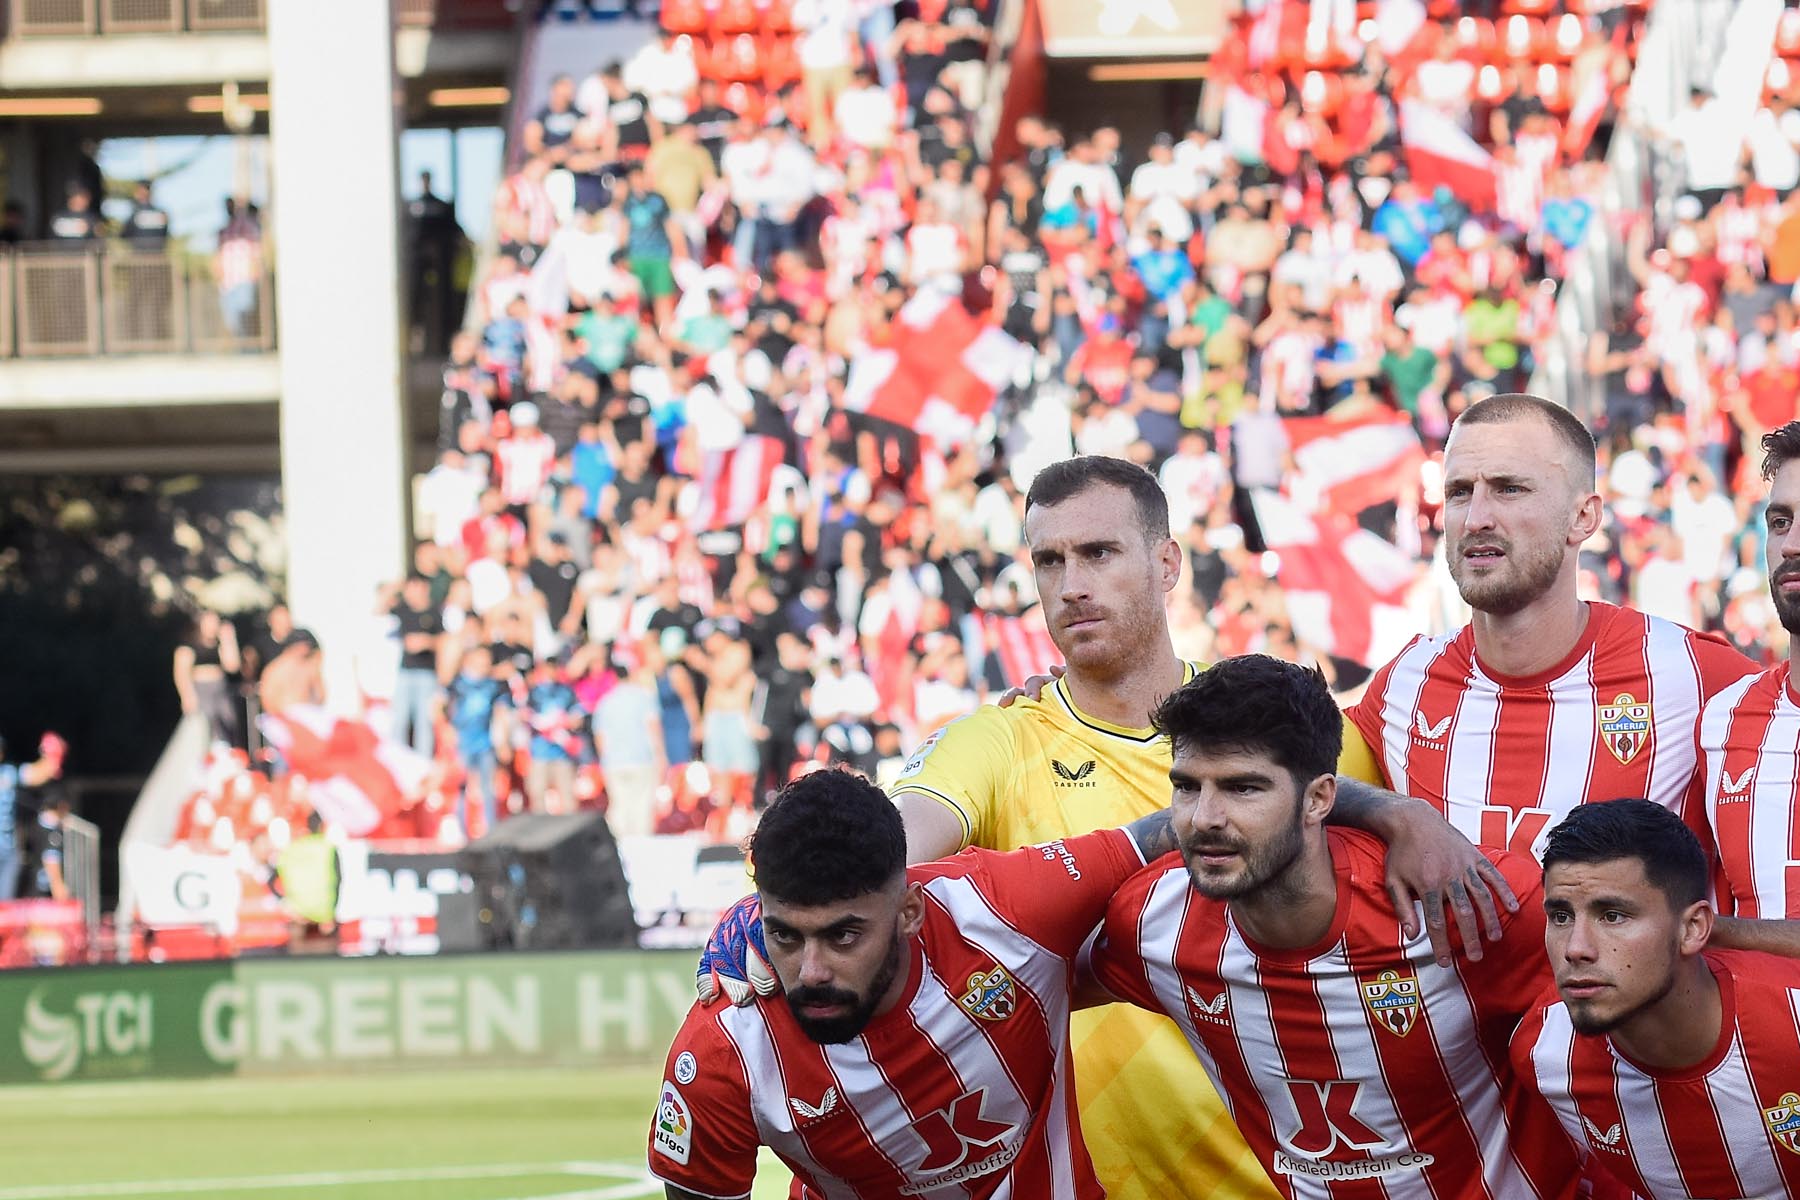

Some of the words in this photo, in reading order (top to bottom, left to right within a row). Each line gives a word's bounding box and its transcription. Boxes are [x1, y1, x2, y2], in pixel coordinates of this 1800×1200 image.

[1604, 709, 1615, 719] U
[1633, 707, 1644, 717] D
[1413, 737, 1445, 751] CASTORE
[1719, 794, 1749, 805] CASTORE
[965, 993, 977, 1004] U
[991, 973, 1001, 985] D
[1369, 986, 1381, 995] U
[1399, 983, 1411, 992] D
[76, 991, 153, 1053] TCI
[202, 974, 541, 1064] GREEN
[1194, 1012, 1229, 1026] CASTORE
[1771, 1111, 1782, 1120] U
[902, 1168, 964, 1194] Khaled
[970, 1141, 1021, 1175] Juffali
[1278, 1152, 1330, 1177] Khaled
[1336, 1157, 1391, 1177] Juffali
[1397, 1152, 1430, 1167] Co.
